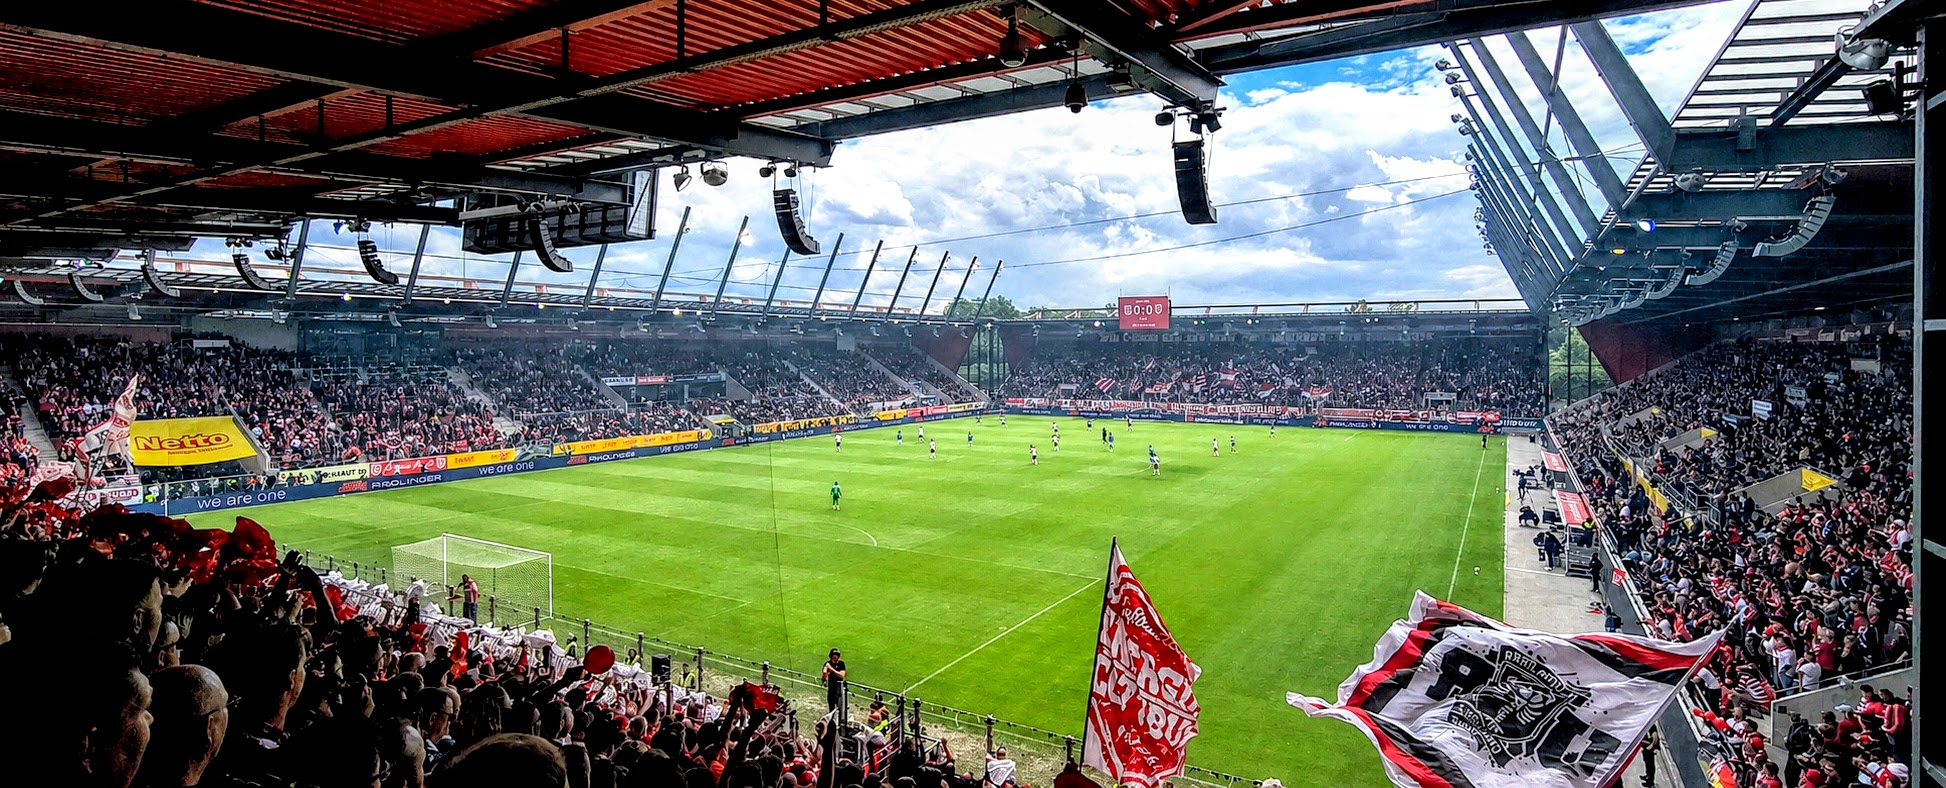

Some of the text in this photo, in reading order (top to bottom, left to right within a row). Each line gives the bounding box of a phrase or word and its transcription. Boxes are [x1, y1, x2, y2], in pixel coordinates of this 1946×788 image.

[135, 432, 230, 451] Netto
[479, 464, 495, 475] we
[515, 460, 535, 471] one
[197, 489, 286, 509] we are one
